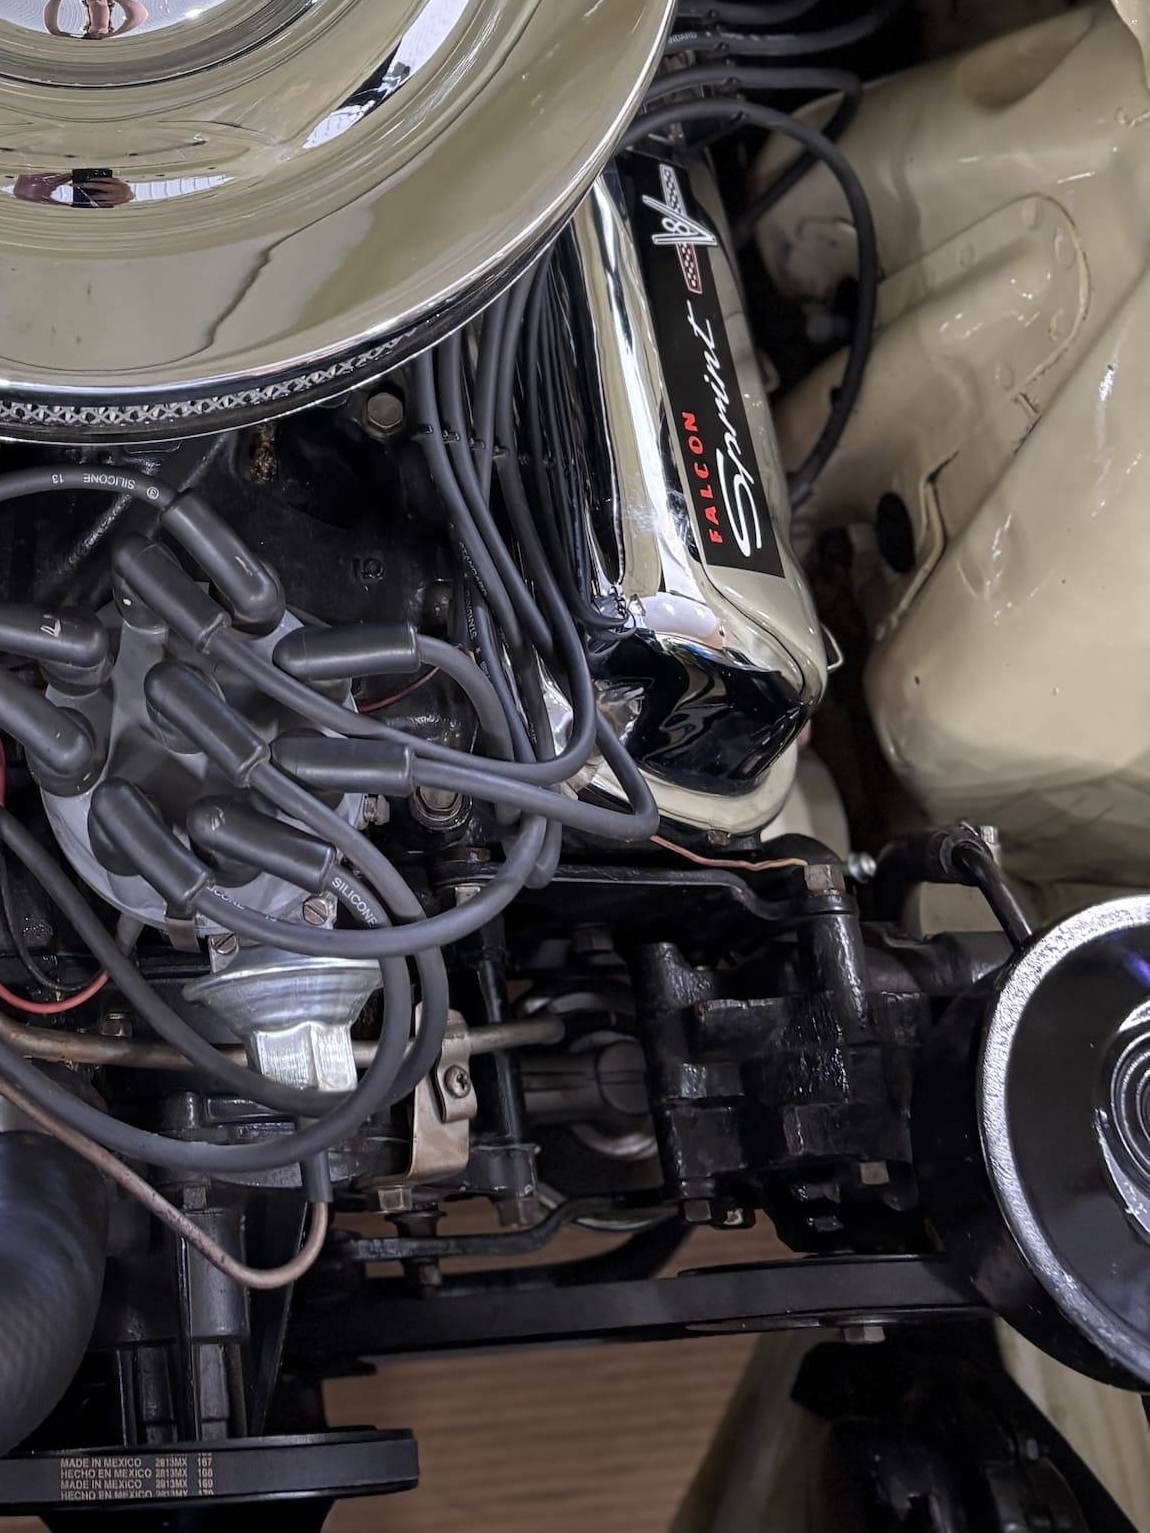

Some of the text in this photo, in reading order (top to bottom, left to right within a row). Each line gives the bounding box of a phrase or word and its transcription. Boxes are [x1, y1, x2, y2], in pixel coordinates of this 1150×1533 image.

[687, 300, 762, 558] Sprint
[52, 473, 135, 489] SILICONE 13
[681, 411, 724, 544] FALCON
[332, 877, 378, 926] SILICONE
[60, 1458, 89, 1468] MADE
[92, 1458, 102, 1467] IN
[105, 1458, 141, 1467] MEXICO
[198, 1458, 212, 1467] 167
[61, 1469, 95, 1479] HECHO
[99, 1469, 111, 1478] EN
[114, 1469, 152, 1478] MEXICO
[60, 1480, 89, 1489] MADE
[92, 1480, 102, 1489] IN
[105, 1479, 142, 1489] MEXICO
[198, 1479, 213, 1488] 169
[61, 1491, 95, 1501] HECHO
[99, 1491, 111, 1499] EN
[114, 1491, 152, 1499] MEXICO
